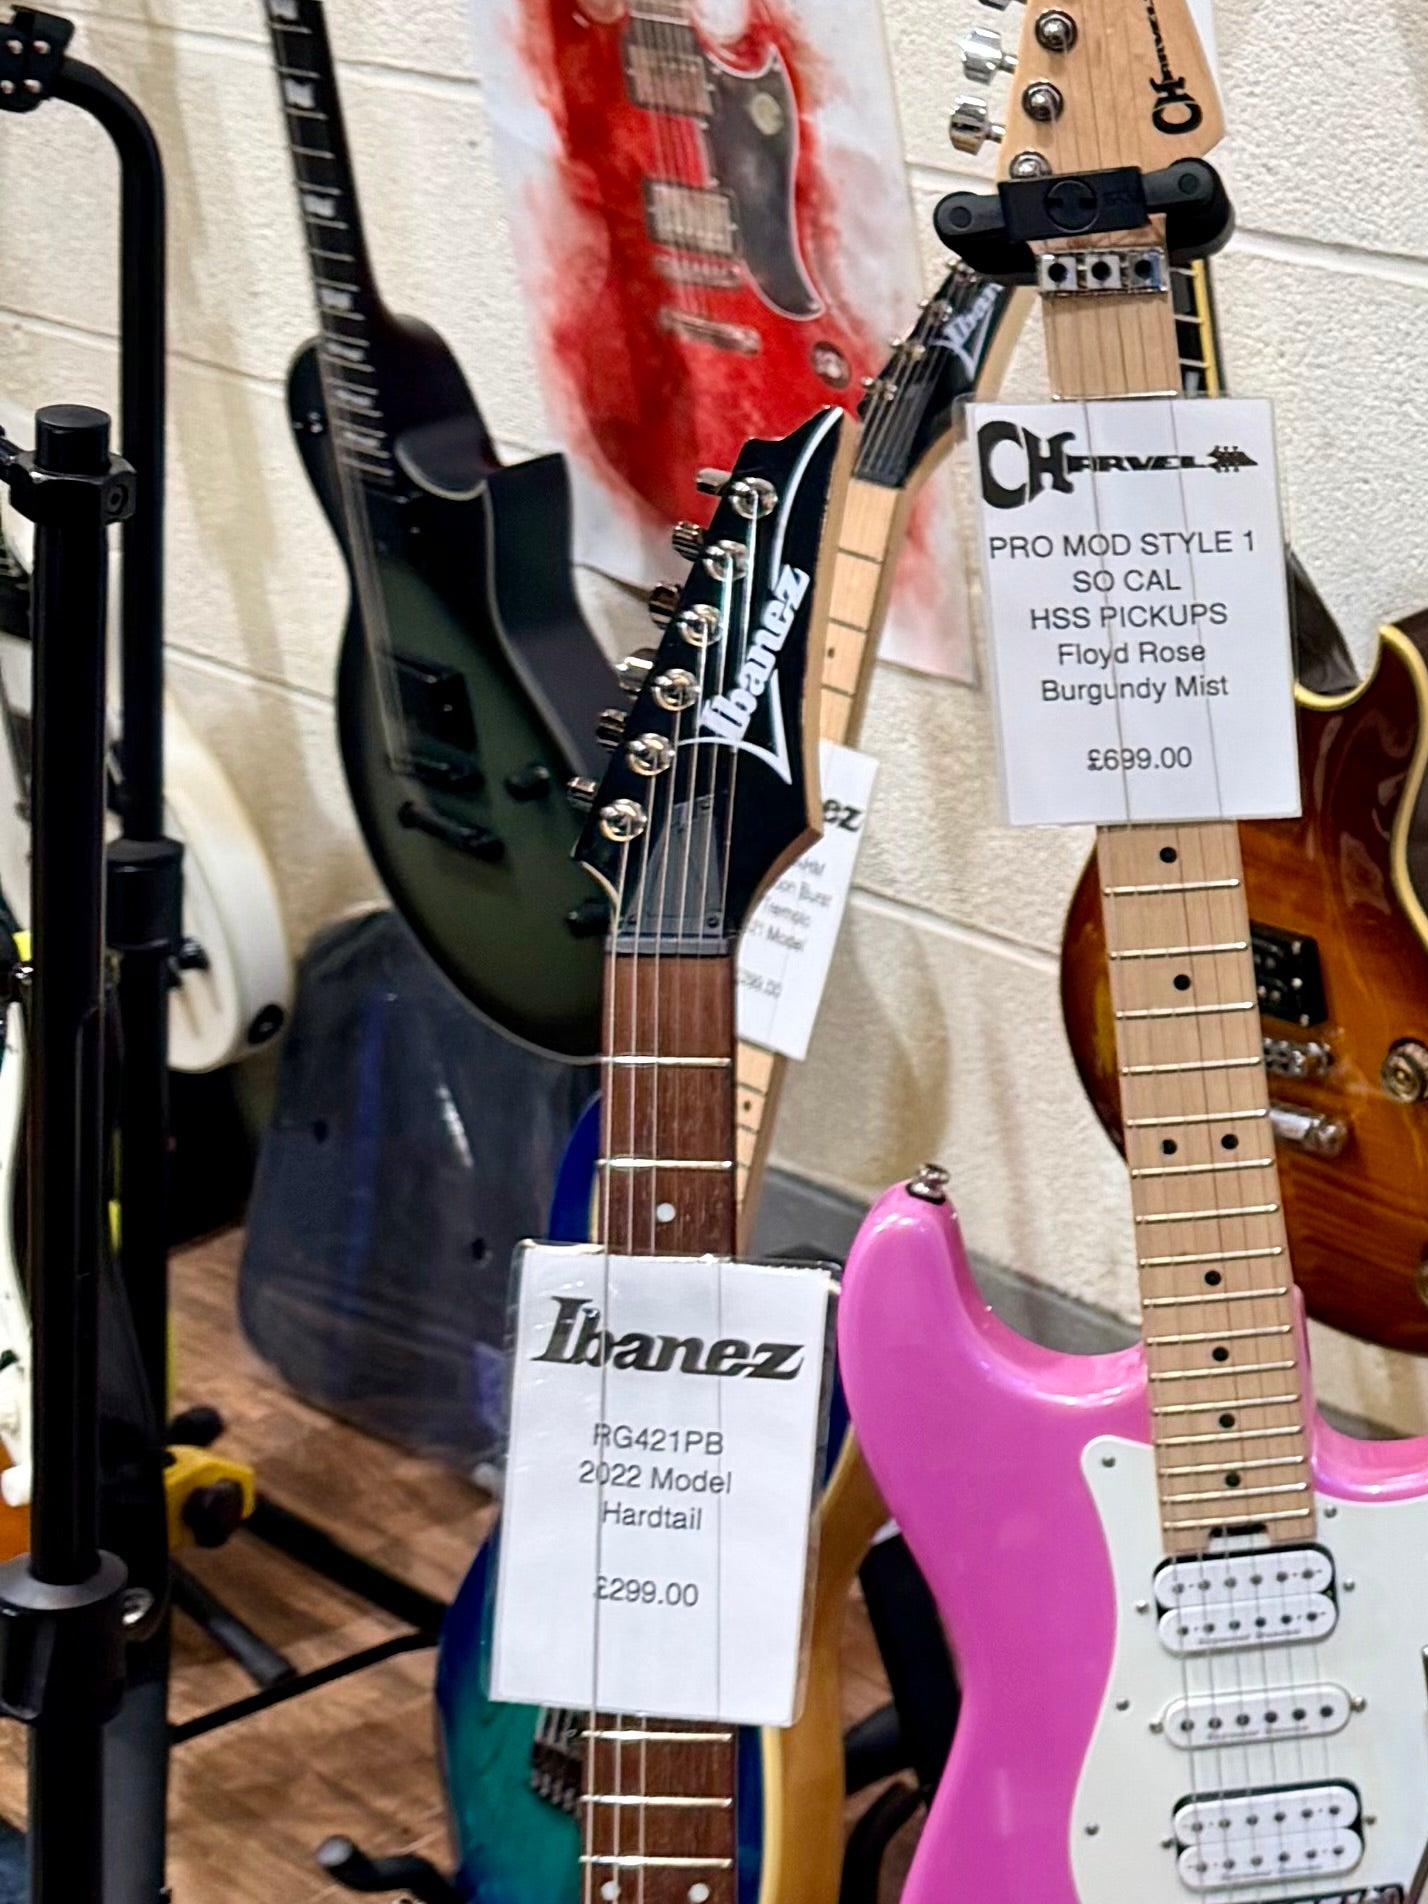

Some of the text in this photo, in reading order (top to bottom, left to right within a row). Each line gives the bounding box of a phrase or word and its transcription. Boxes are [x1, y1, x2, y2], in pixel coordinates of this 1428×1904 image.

[989, 530, 1254, 559] PRO MOD STYLE 1
[1072, 569, 1181, 593] SO CAL
[1031, 603, 1228, 630] HSS PICKUPS
[700, 564, 810, 742] Ibanez
[1057, 642, 1206, 668] Floyd Rose
[1041, 675, 1229, 706] Burgundy Mist
[1087, 747, 1192, 772] £699.00
[531, 1295, 805, 1381] Ibanez
[592, 1423, 724, 1456] RG421PB
[579, 1461, 732, 1494] 2022 Model
[602, 1501, 702, 1530] Hardtail
[593, 1576, 699, 1607] £299.00
